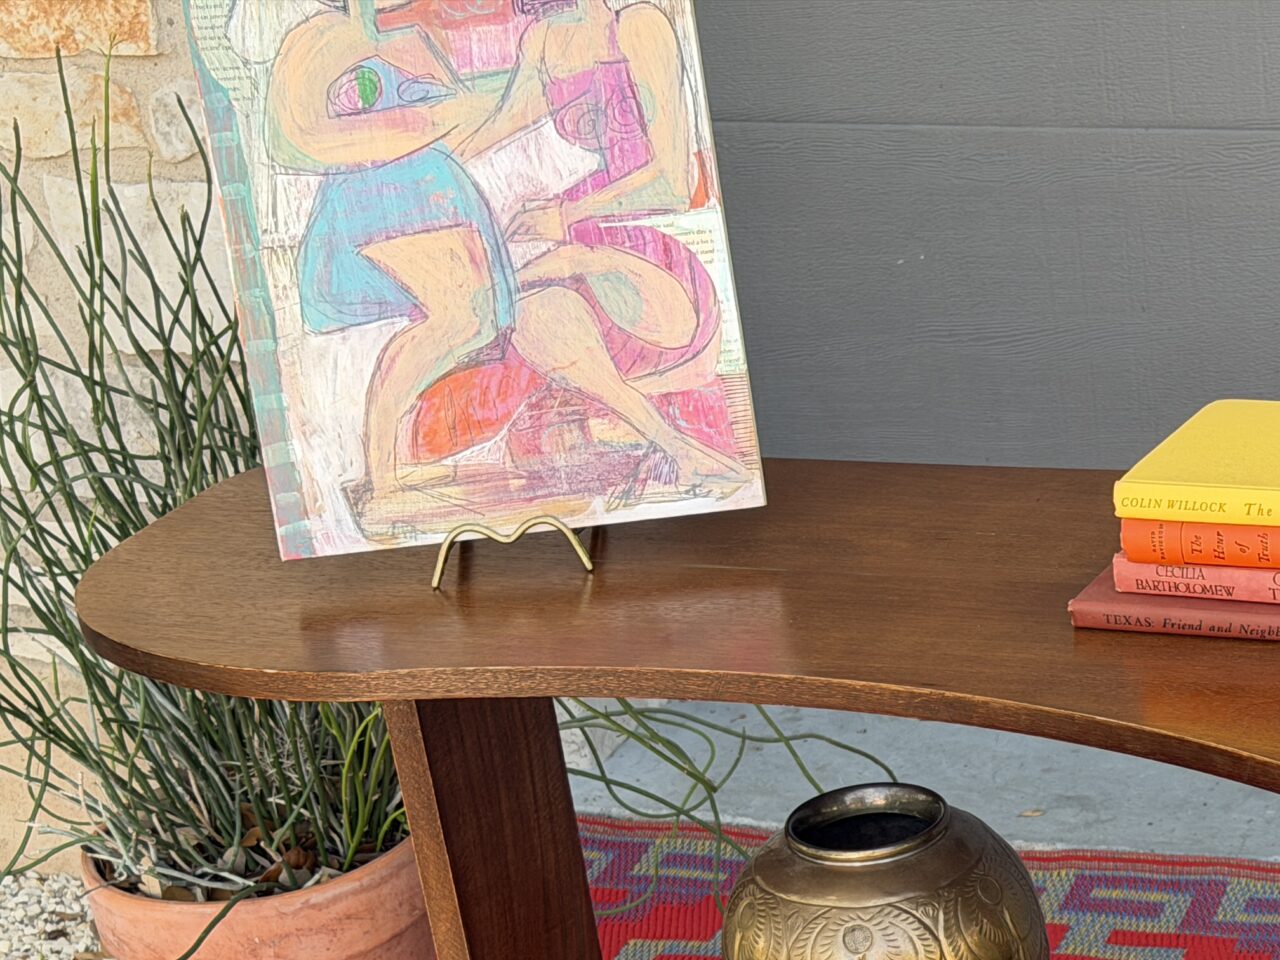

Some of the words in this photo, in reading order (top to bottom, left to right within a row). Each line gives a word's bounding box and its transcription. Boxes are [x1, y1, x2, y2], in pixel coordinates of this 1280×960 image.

[1121, 497, 1163, 509] COLIN
[1167, 499, 1227, 513] WILLOCK
[1244, 502, 1273, 517] The
[1191, 534, 1203, 554] The
[1214, 531, 1226, 560] Hour
[1235, 541, 1250, 554] of
[1258, 532, 1271, 563] Truth
[1155, 565, 1208, 580] CECILIA
[1135, 578, 1236, 598] BARTHOLOMEW
[1103, 613, 1154, 628] TEXAS:
[1162, 617, 1203, 632] Friend
[1209, 621, 1233, 634] and
